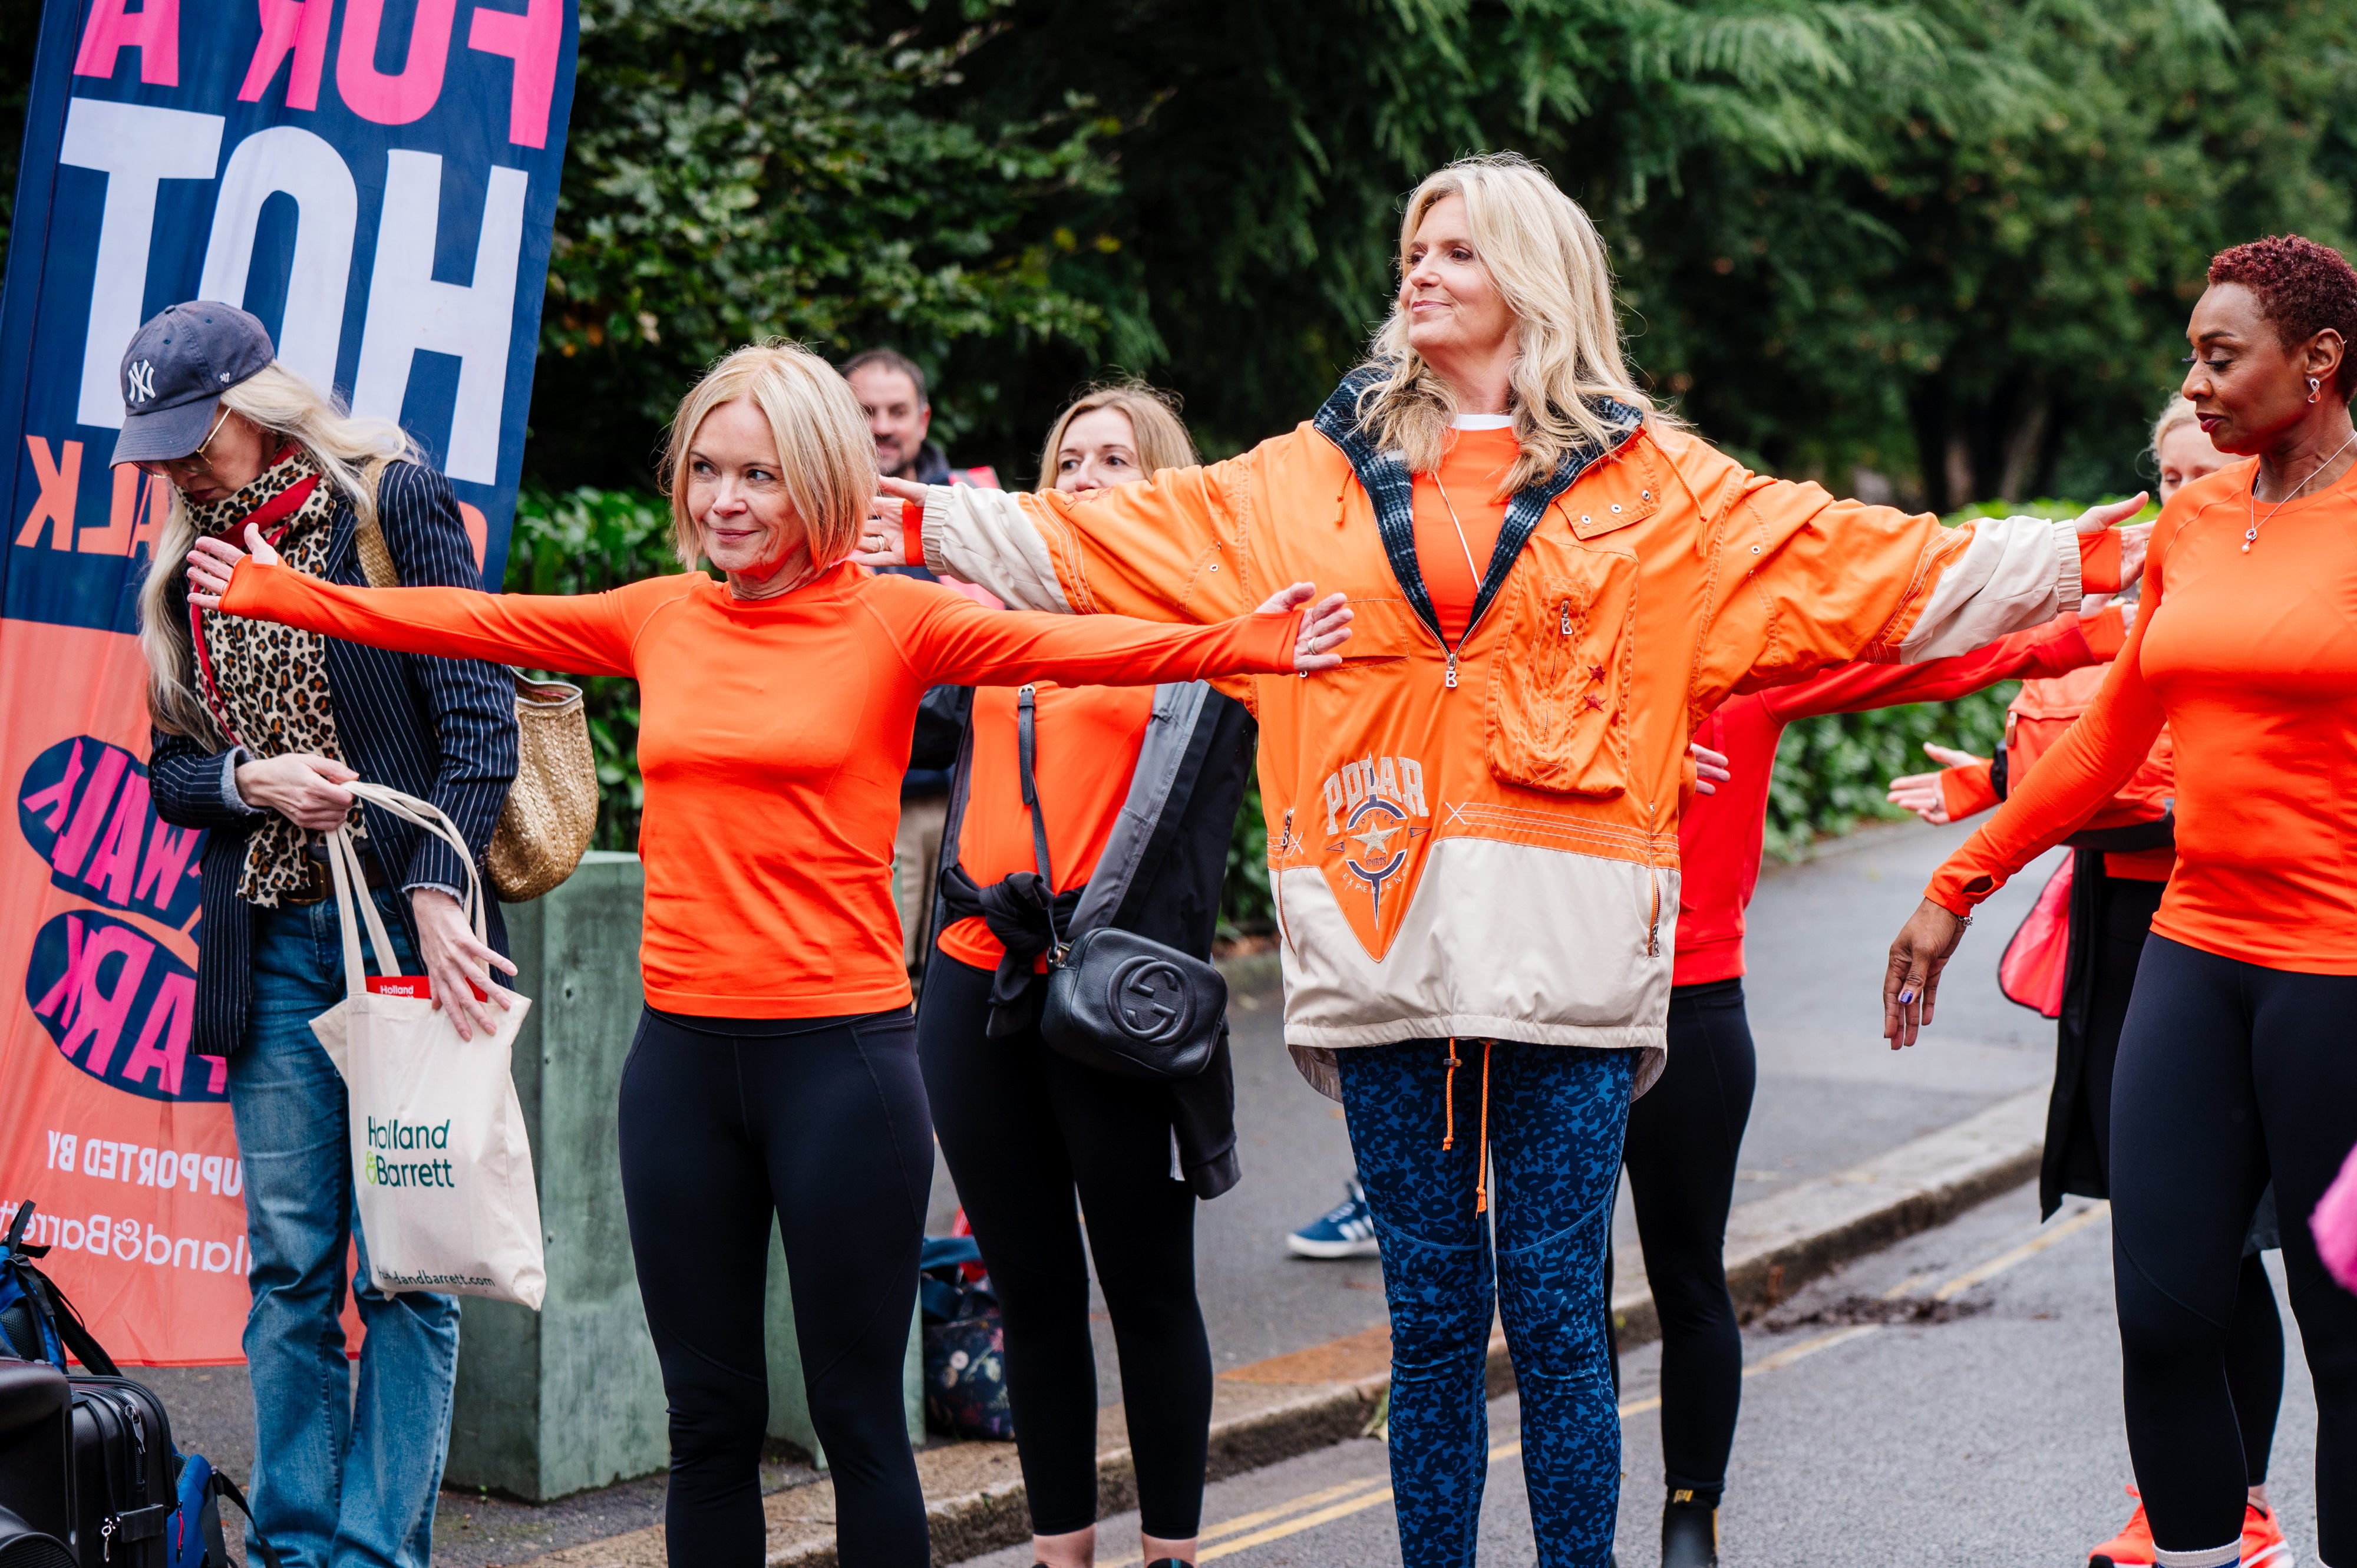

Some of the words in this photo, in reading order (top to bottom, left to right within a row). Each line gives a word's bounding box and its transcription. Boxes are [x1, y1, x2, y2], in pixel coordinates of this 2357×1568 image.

[128, 359, 156, 403] NY
[1323, 757, 1430, 836] POLAR
[1342, 861, 1411, 893] EXPERIENCE
[1366, 856, 1387, 868] SPORTS
[380, 985, 414, 995] Holland
[368, 1115, 451, 1150] Holland
